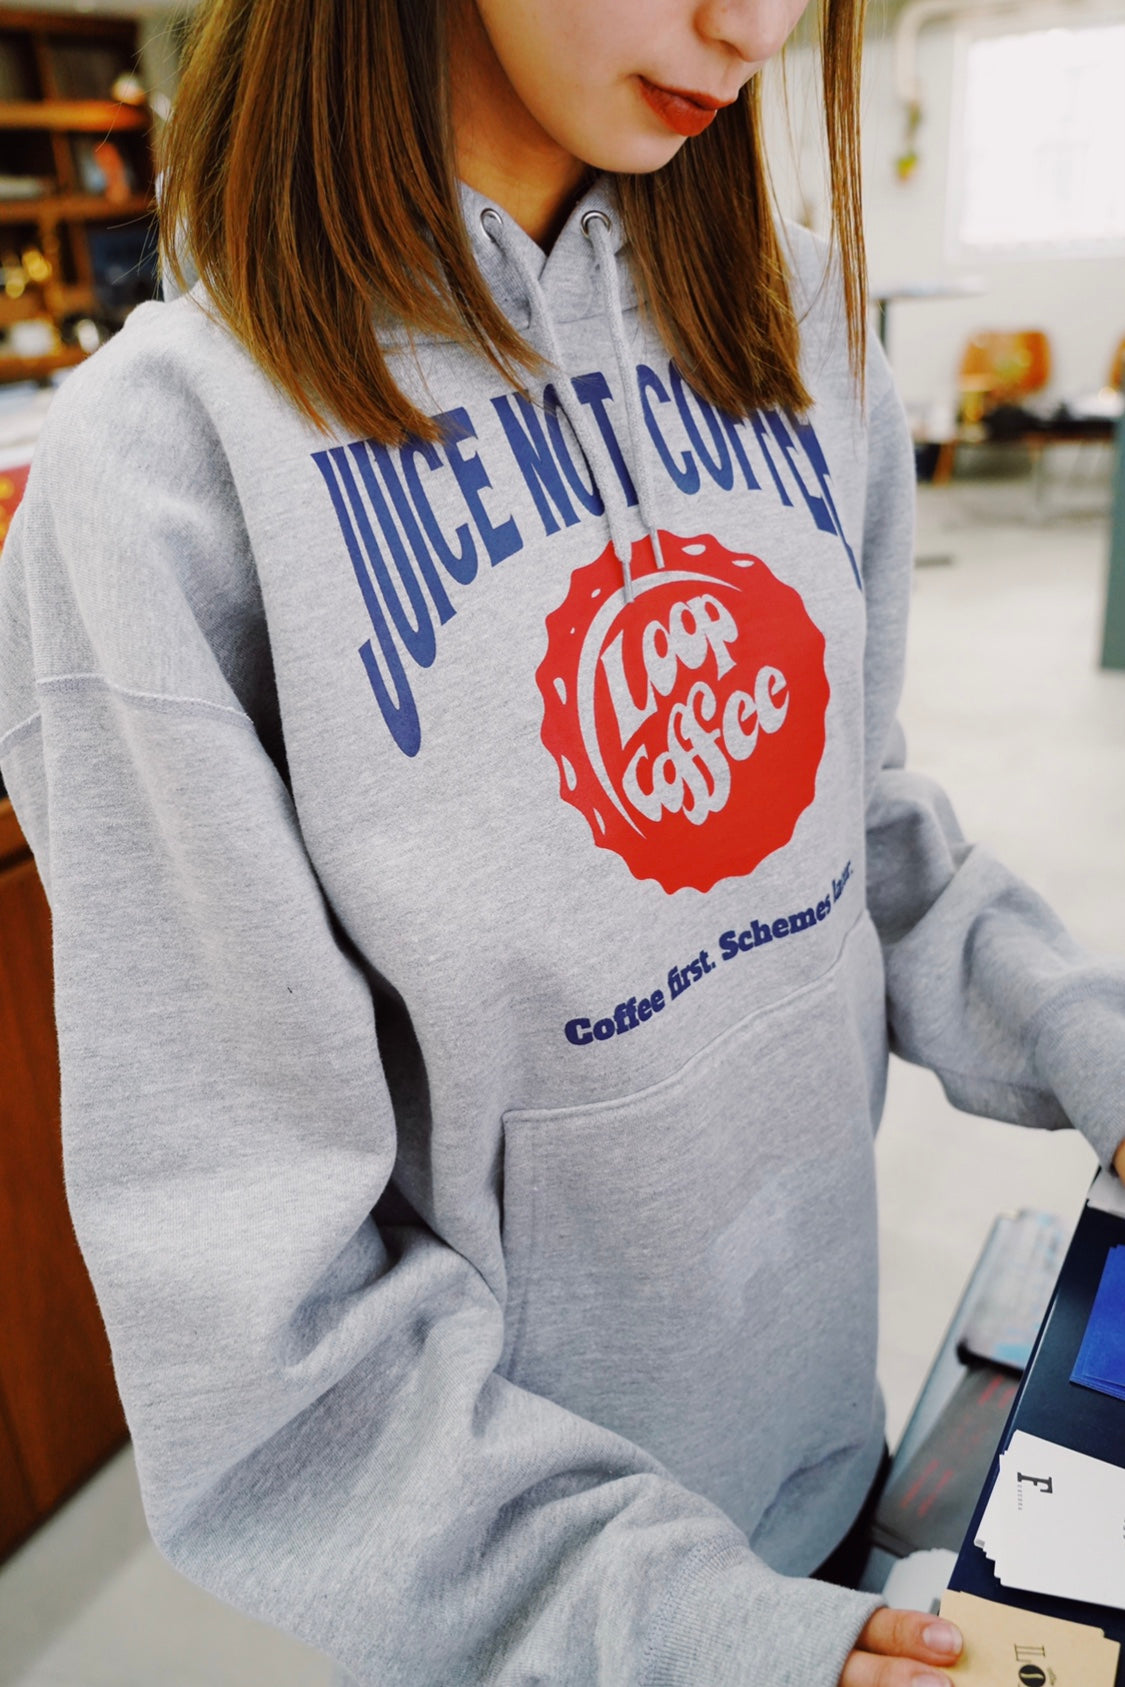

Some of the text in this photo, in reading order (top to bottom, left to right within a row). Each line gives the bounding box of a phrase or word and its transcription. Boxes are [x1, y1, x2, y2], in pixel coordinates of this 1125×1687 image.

[497, 371, 639, 536] NOT
[599, 593, 740, 751] Loop
[621, 665, 790, 827] Coffee
[564, 989, 666, 1046] Coffee
[667, 950, 717, 1001] first.
[718, 895, 832, 962] Schemes
